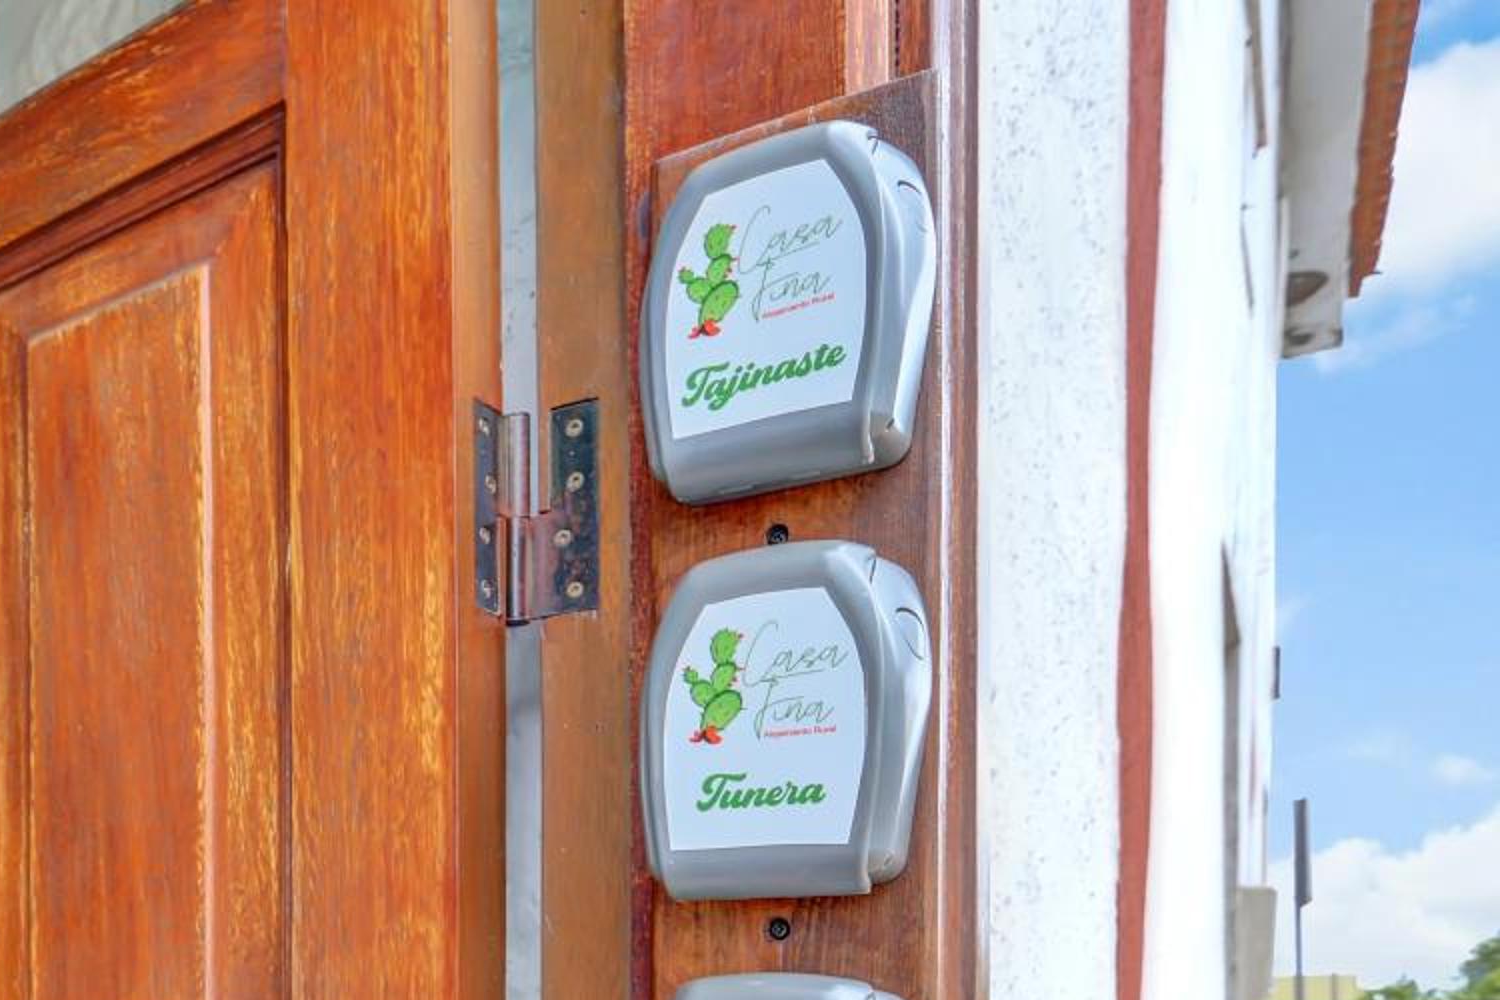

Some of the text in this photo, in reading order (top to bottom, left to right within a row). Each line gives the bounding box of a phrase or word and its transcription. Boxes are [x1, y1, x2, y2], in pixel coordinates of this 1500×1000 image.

[739, 205, 842, 275] Casa
[681, 343, 847, 411] Tajinaste
[743, 620, 848, 688] Casa
[754, 678, 834, 741] Fina
[696, 773, 825, 812] Tunera
